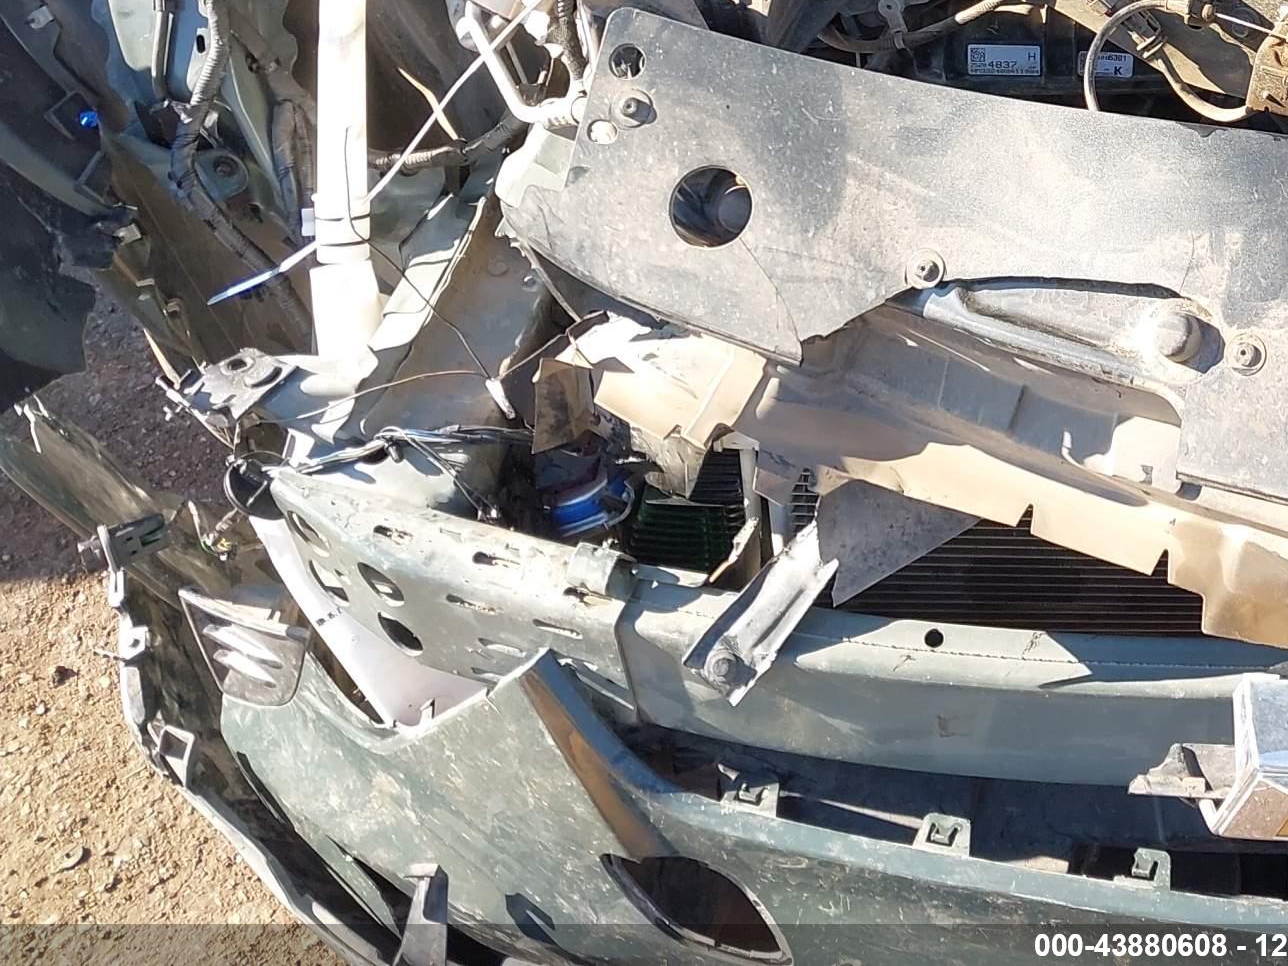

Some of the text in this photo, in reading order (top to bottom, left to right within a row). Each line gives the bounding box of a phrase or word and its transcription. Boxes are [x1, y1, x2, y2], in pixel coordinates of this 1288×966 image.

[1027, 52, 1037, 62] H
[987, 59, 1018, 70] 4837
[1113, 65, 1123, 76] K
